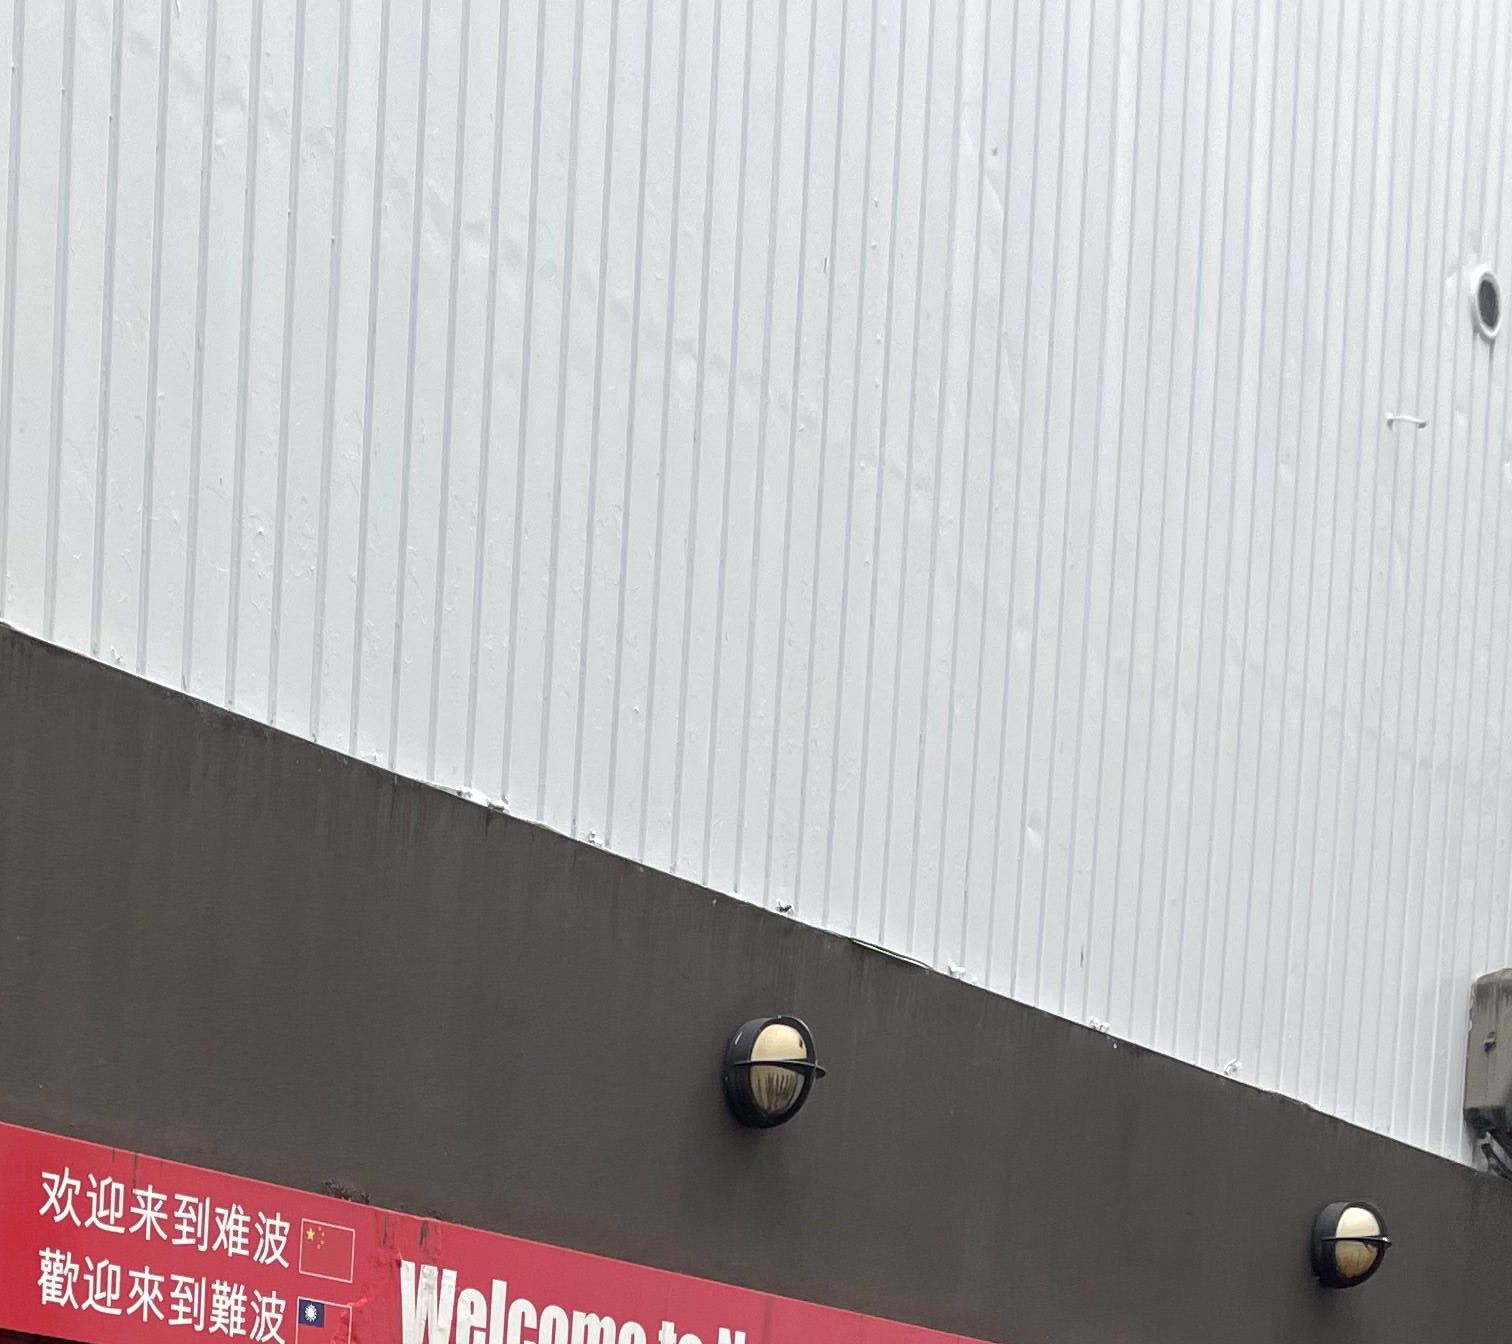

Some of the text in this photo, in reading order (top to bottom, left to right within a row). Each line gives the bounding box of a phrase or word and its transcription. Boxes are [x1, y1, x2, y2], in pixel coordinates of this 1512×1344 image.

[39, 1167, 291, 1268] 欢迎来到难波
